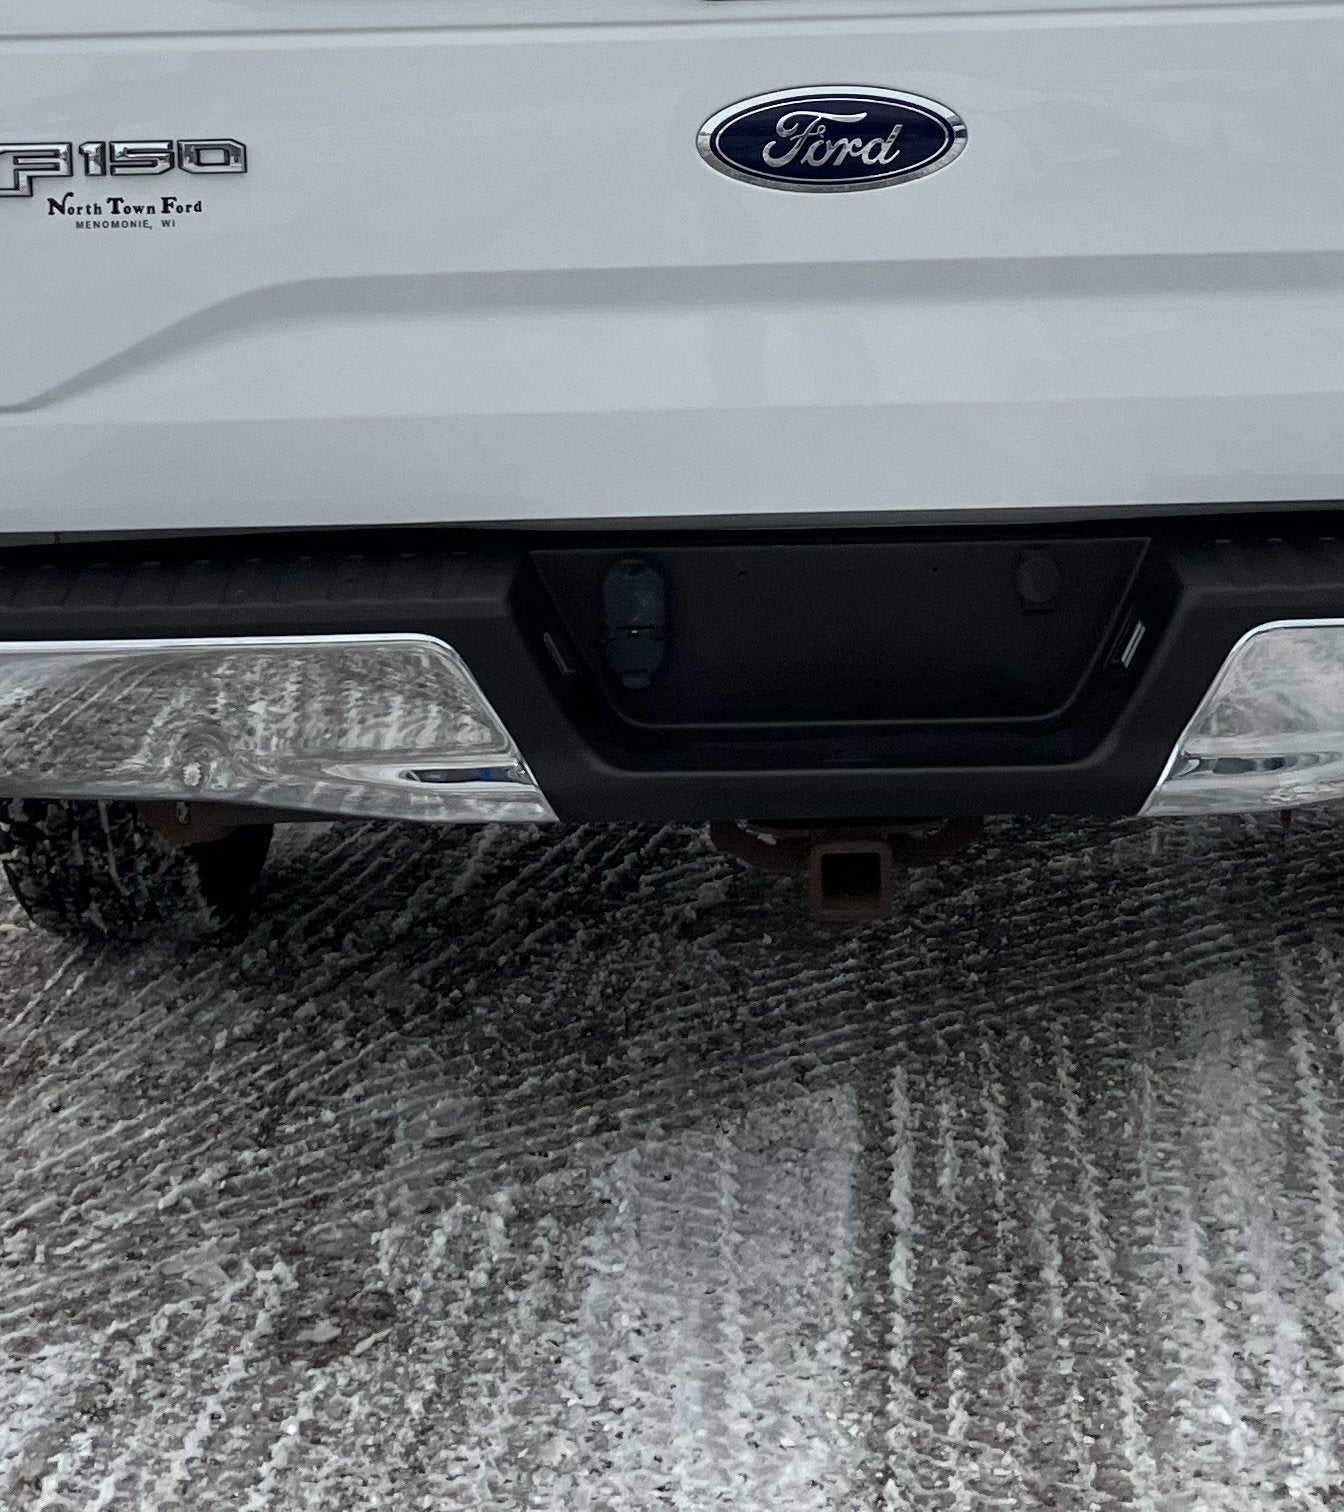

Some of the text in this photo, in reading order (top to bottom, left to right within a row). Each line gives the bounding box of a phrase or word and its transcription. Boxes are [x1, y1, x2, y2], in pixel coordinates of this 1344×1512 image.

[761, 110, 904, 168] Ford
[47, 191, 203, 216] North Town Ford
[75, 219, 176, 230] MENOMONIE, WI
